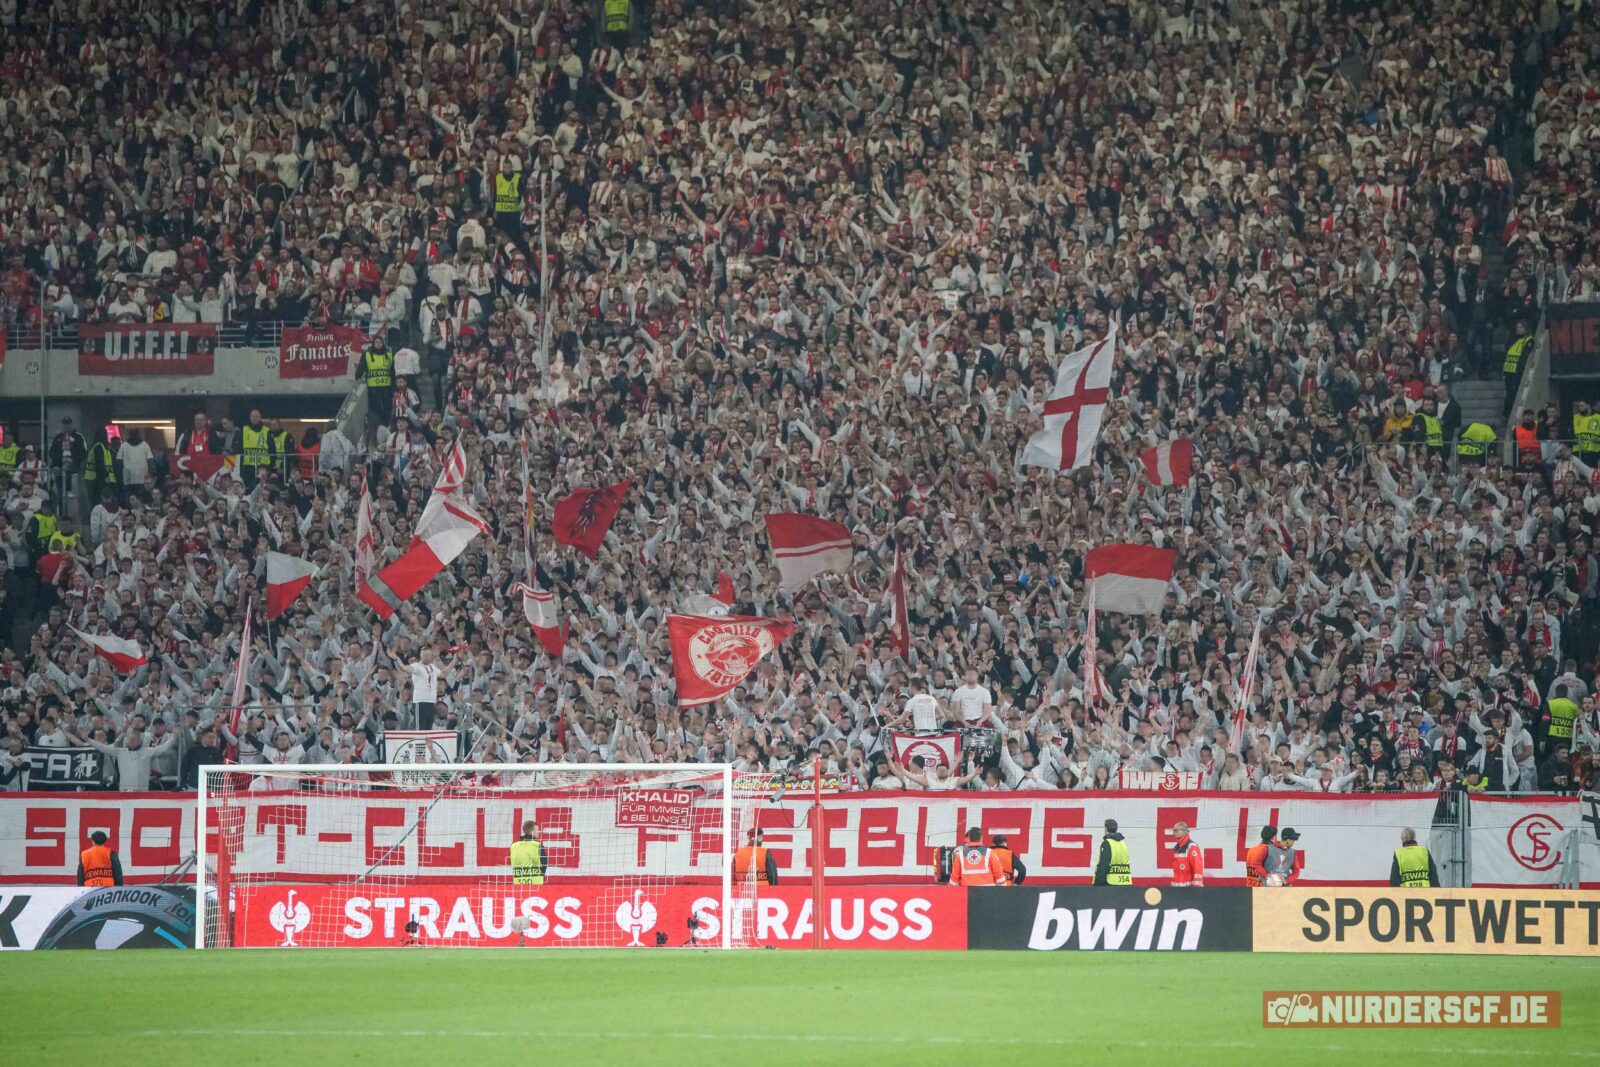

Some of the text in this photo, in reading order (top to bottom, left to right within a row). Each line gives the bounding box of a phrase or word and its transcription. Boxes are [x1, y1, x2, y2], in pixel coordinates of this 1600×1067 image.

[284, 342, 352, 362] Fanatics
[621, 802, 689, 816] FÜR IMMER
[622, 791, 690, 804] KHALID
[631, 814, 678, 824] BEI UNS
[343, 897, 583, 939] STRAUSS
[692, 897, 933, 940] STRAUSS
[1027, 887, 1204, 950] bwin
[1302, 897, 1600, 946] SPORTWETT
